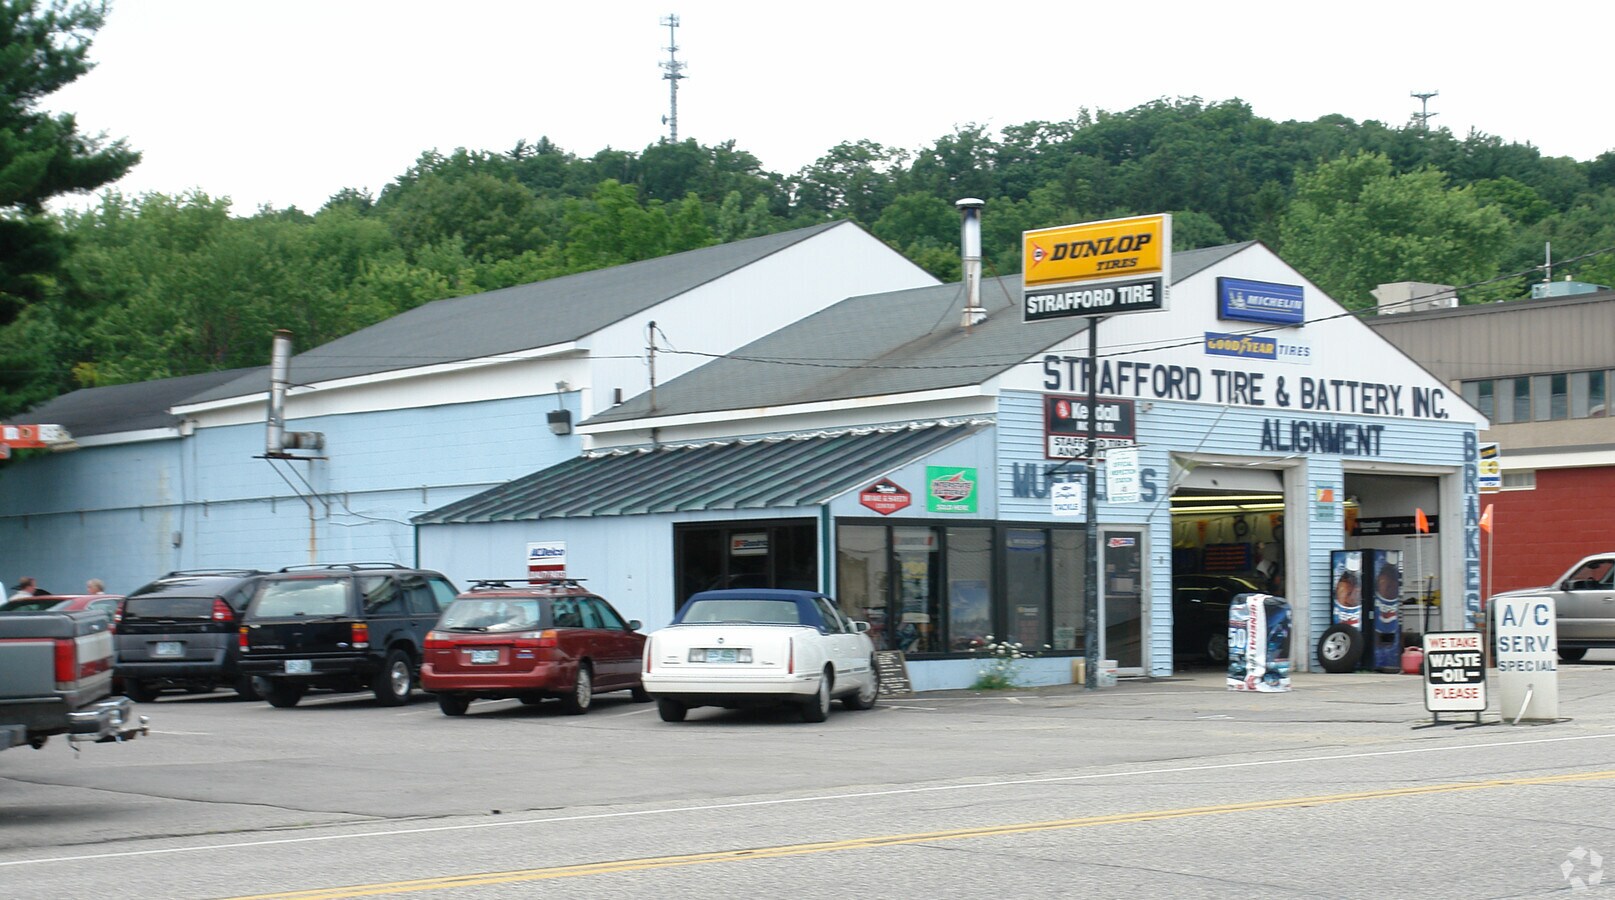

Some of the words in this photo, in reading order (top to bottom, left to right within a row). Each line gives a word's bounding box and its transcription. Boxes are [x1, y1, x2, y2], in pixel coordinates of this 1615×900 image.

[1050, 233, 1152, 261] DUNLOP
[1097, 257, 1138, 271] TIRES
[1027, 288, 1114, 314] STRAFFORD
[1117, 284, 1153, 304] TIRE
[1247, 295, 1303, 309] MICHELIN
[1279, 345, 1310, 357] TIRES
[1211, 369, 1264, 406] TIRE
[1276, 376, 1290, 407] &
[1071, 402, 1120, 421] Kedall
[1261, 418, 1384, 456] ALIGNMENT
[1463, 431, 1480, 625] BRAKES
[1501, 603, 1550, 627] A/C
[1429, 638, 1447, 648] WE
[1450, 637, 1478, 648] TAKE
[1500, 635, 1557, 652] SERV.
[1428, 653, 1481, 667] WASTE
[1499, 660, 1556, 672] SPECIAL
[1434, 688, 1479, 699] PLEASE
